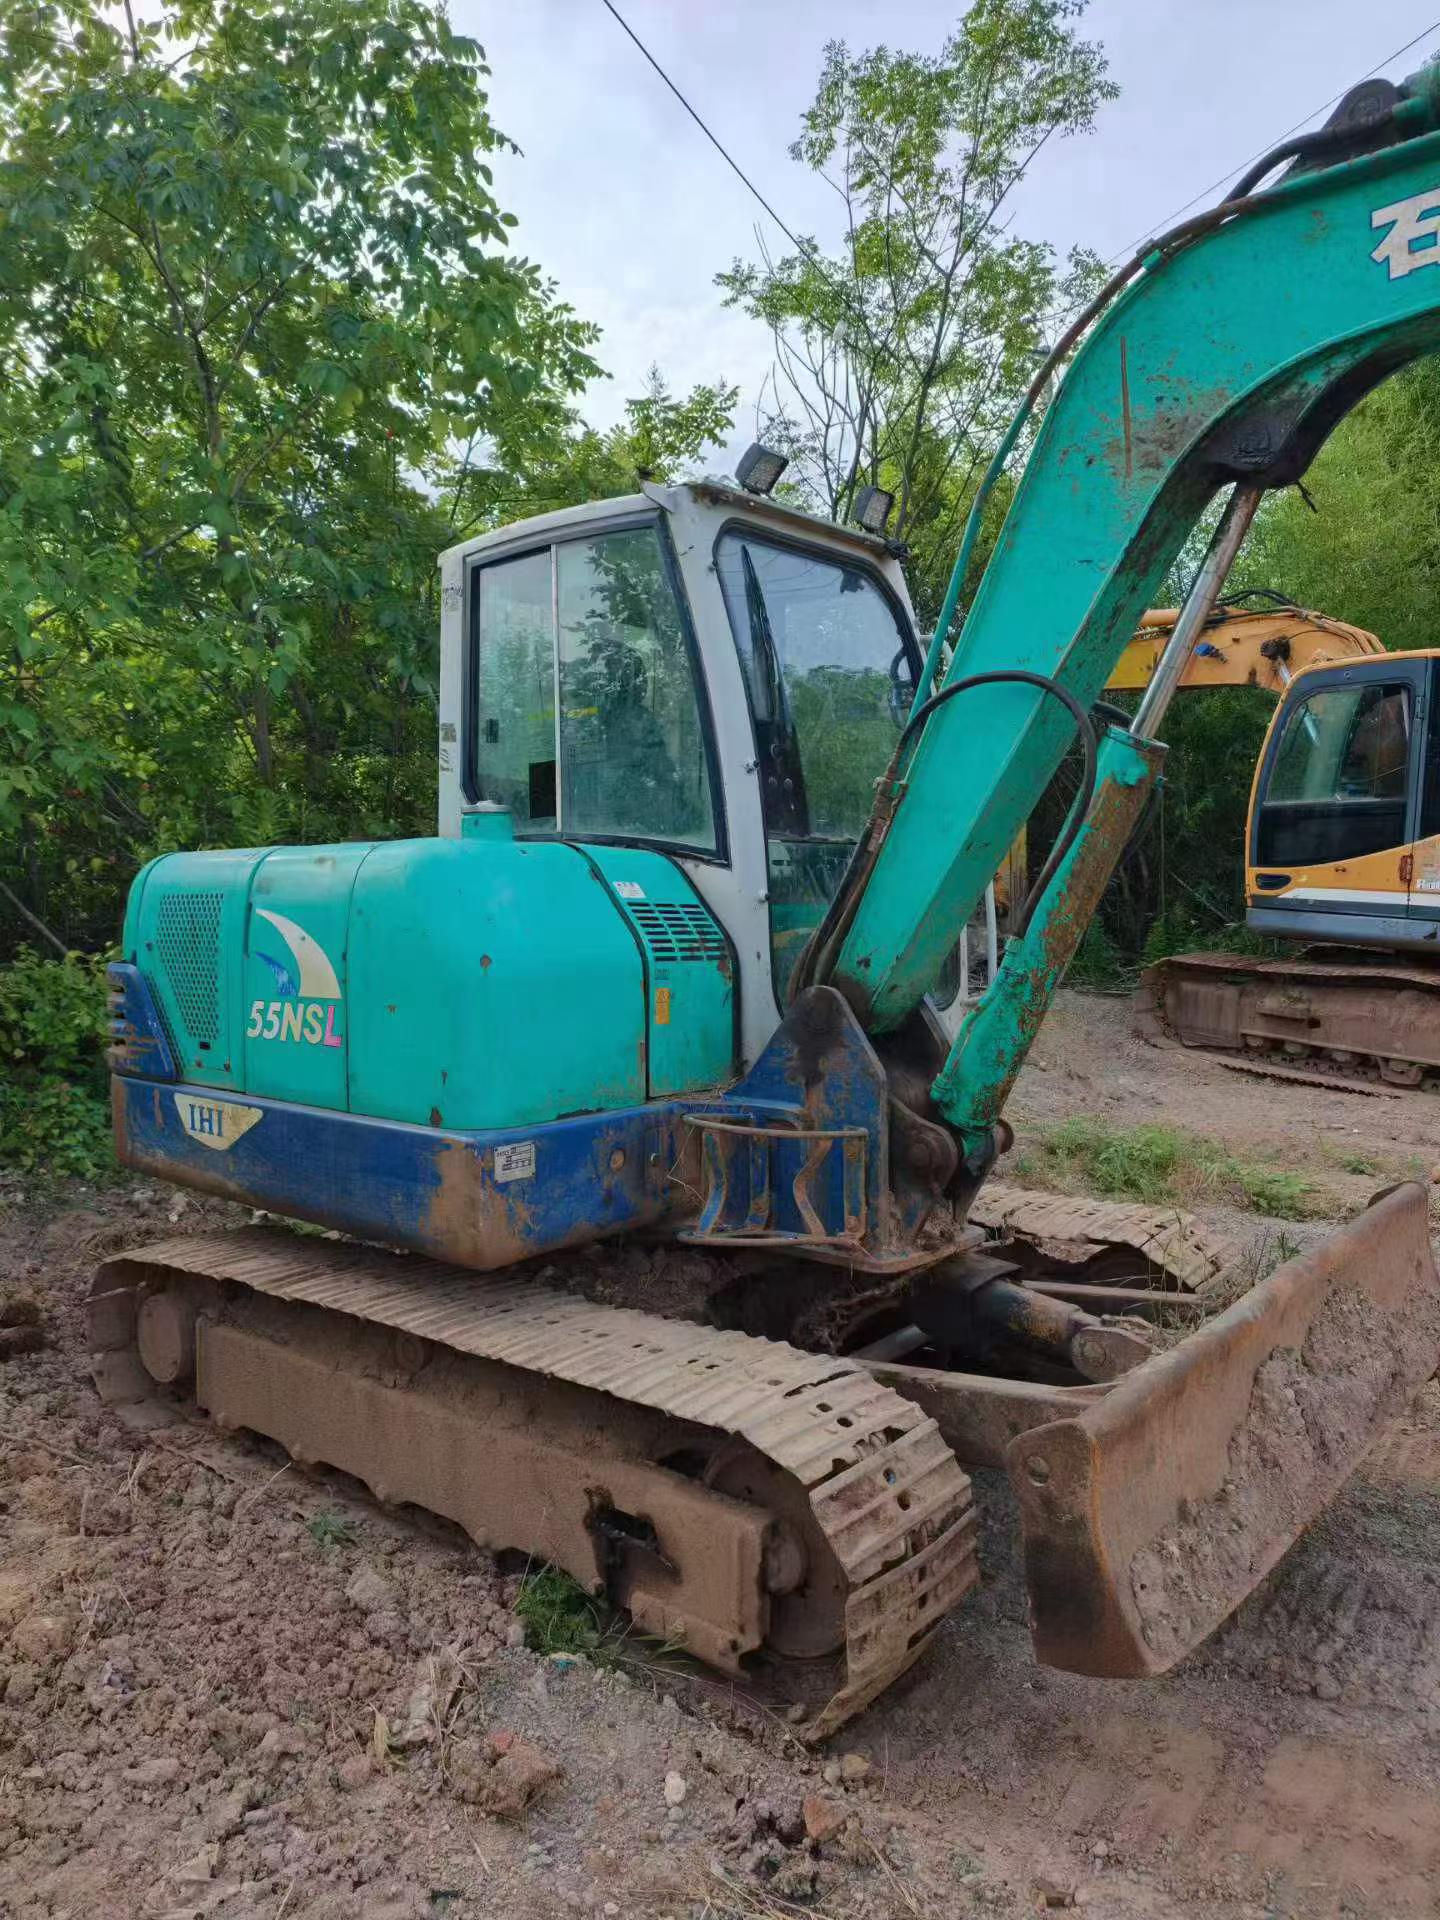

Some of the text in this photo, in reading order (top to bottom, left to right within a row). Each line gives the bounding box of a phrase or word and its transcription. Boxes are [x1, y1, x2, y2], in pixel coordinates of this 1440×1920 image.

[1371, 187, 1440, 280] 石
[247, 1001, 342, 1047] 55NSL
[189, 1104, 224, 1137] IHI
